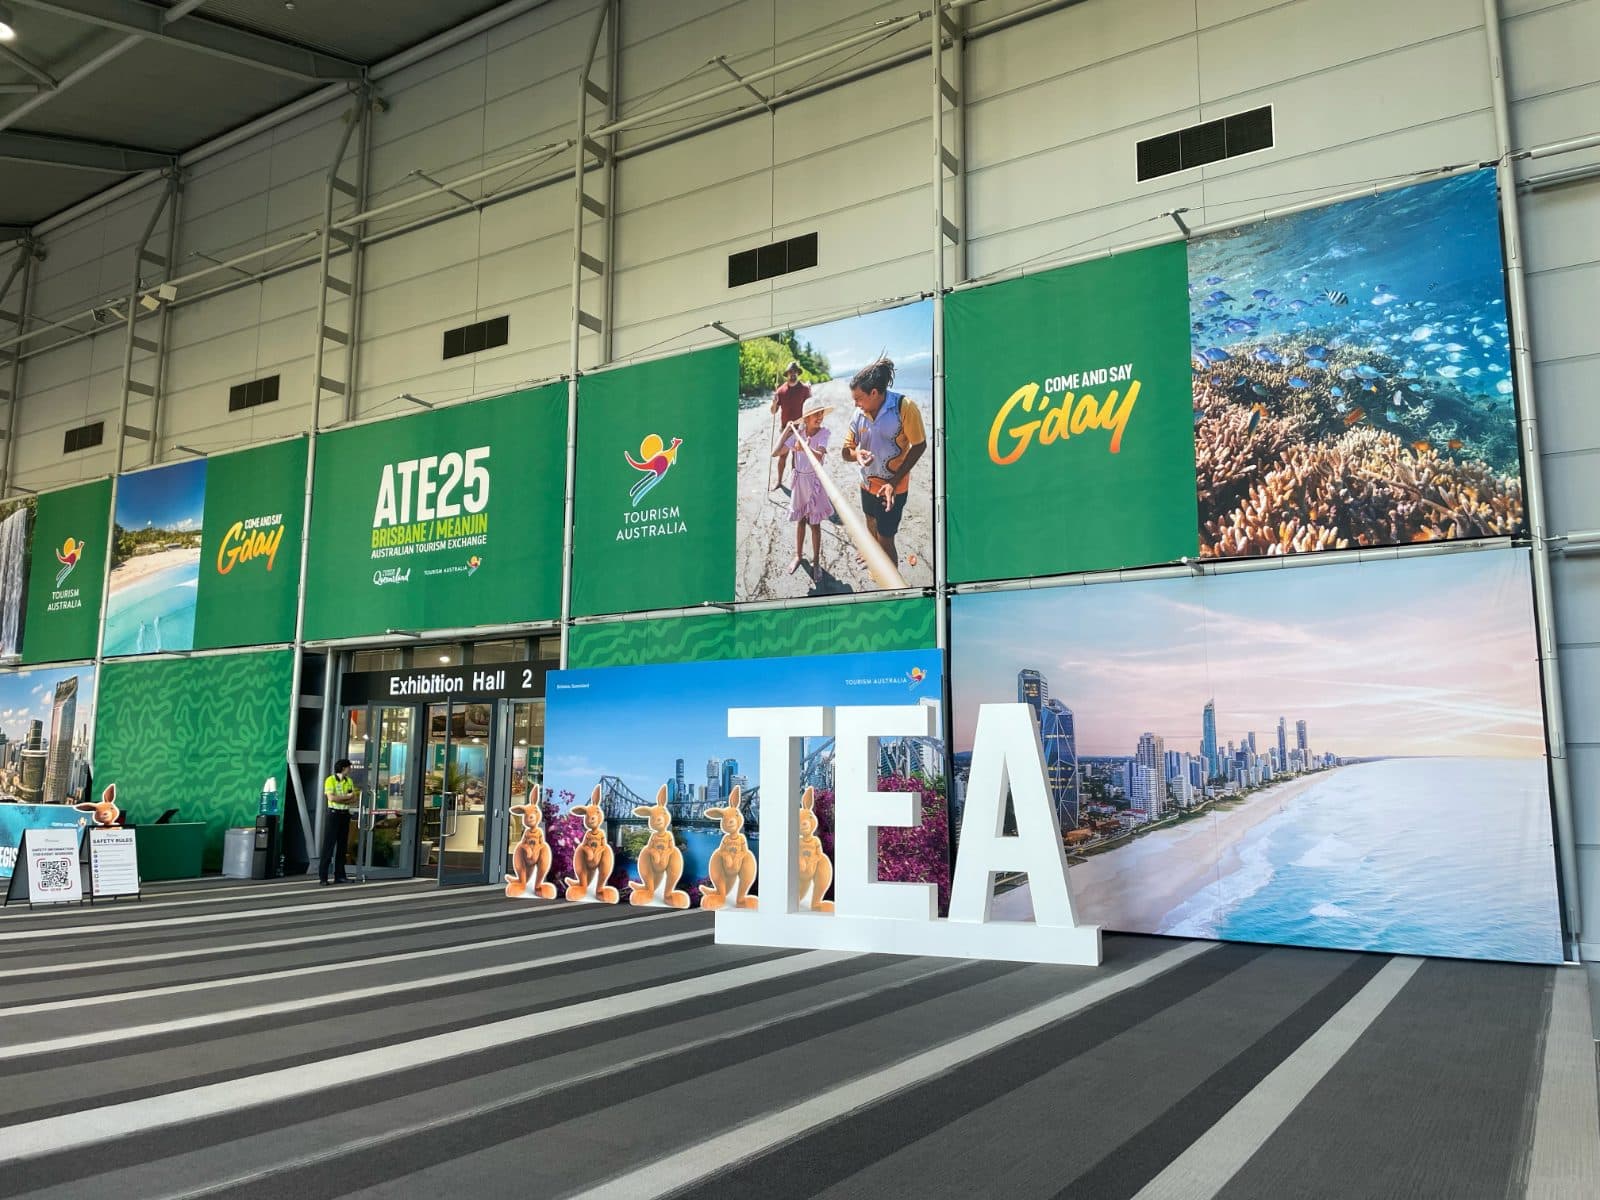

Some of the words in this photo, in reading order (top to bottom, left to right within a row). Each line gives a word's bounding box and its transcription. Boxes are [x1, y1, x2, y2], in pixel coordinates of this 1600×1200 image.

[1045, 374, 1079, 393] COME
[1082, 368, 1107, 387] AND
[1109, 363, 1133, 383] SAY
[988, 380, 1141, 465] G'day
[373, 446, 491, 528] ATE25
[245, 517, 260, 529] COME
[623, 505, 680, 524] TOURISM
[371, 522, 427, 549] BRISBANE
[436, 513, 488, 540] MEANJIN
[616, 521, 687, 541] AUSTRALIA
[217, 521, 285, 574] G'day
[371, 545, 414, 559] AUSTRALIAN
[415, 540, 446, 553] TOURISM
[447, 534, 487, 549] EXCHANGE
[47, 599, 82, 611] AUSTRALIA
[52, 589, 80, 600] TOURISM
[390, 674, 464, 695] Exhibition
[472, 670, 505, 691] Hall
[521, 669, 532, 688] 2
[728, 702, 1079, 928] TEA
